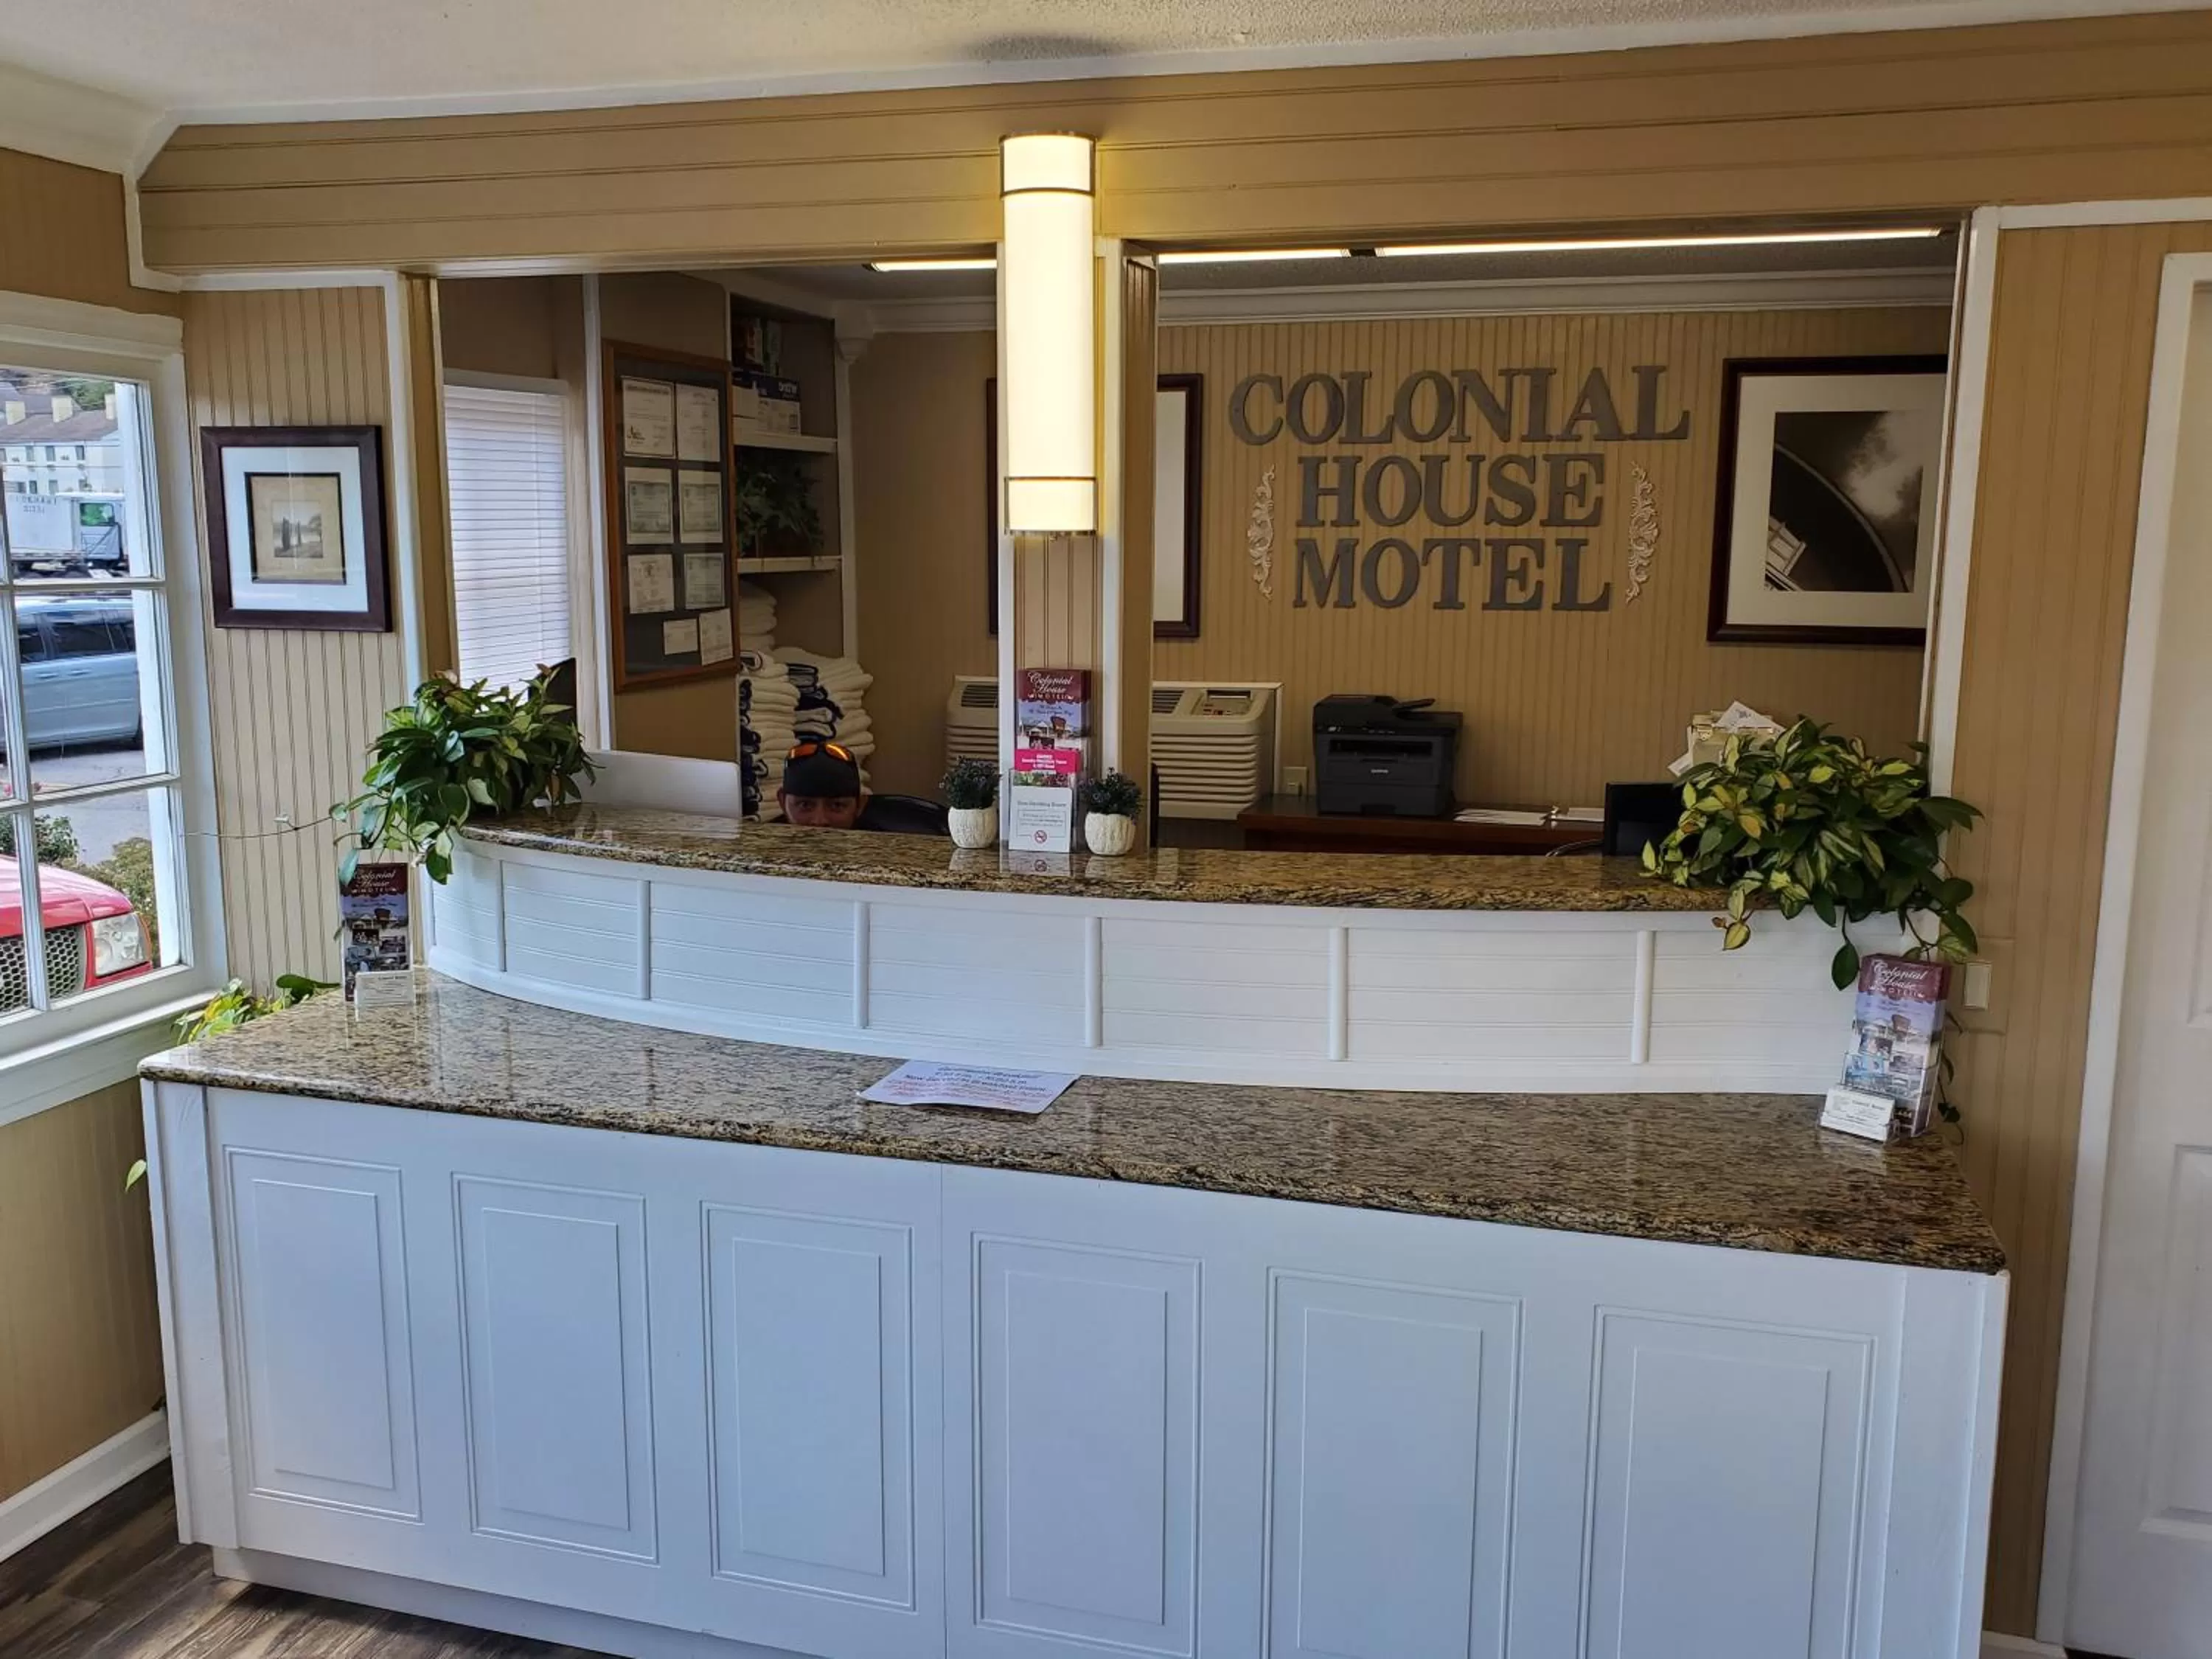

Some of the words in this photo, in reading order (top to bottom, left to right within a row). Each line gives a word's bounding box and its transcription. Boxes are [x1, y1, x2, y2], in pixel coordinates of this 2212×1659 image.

[1229, 365, 1689, 445] COLONIAL
[1296, 453, 1604, 527] HOUSE
[1293, 538, 1612, 611] MOTEL
[1027, 672, 1074, 685] Colonial
[1033, 684, 1067, 694] House
[1872, 959, 1928, 980] Colonial
